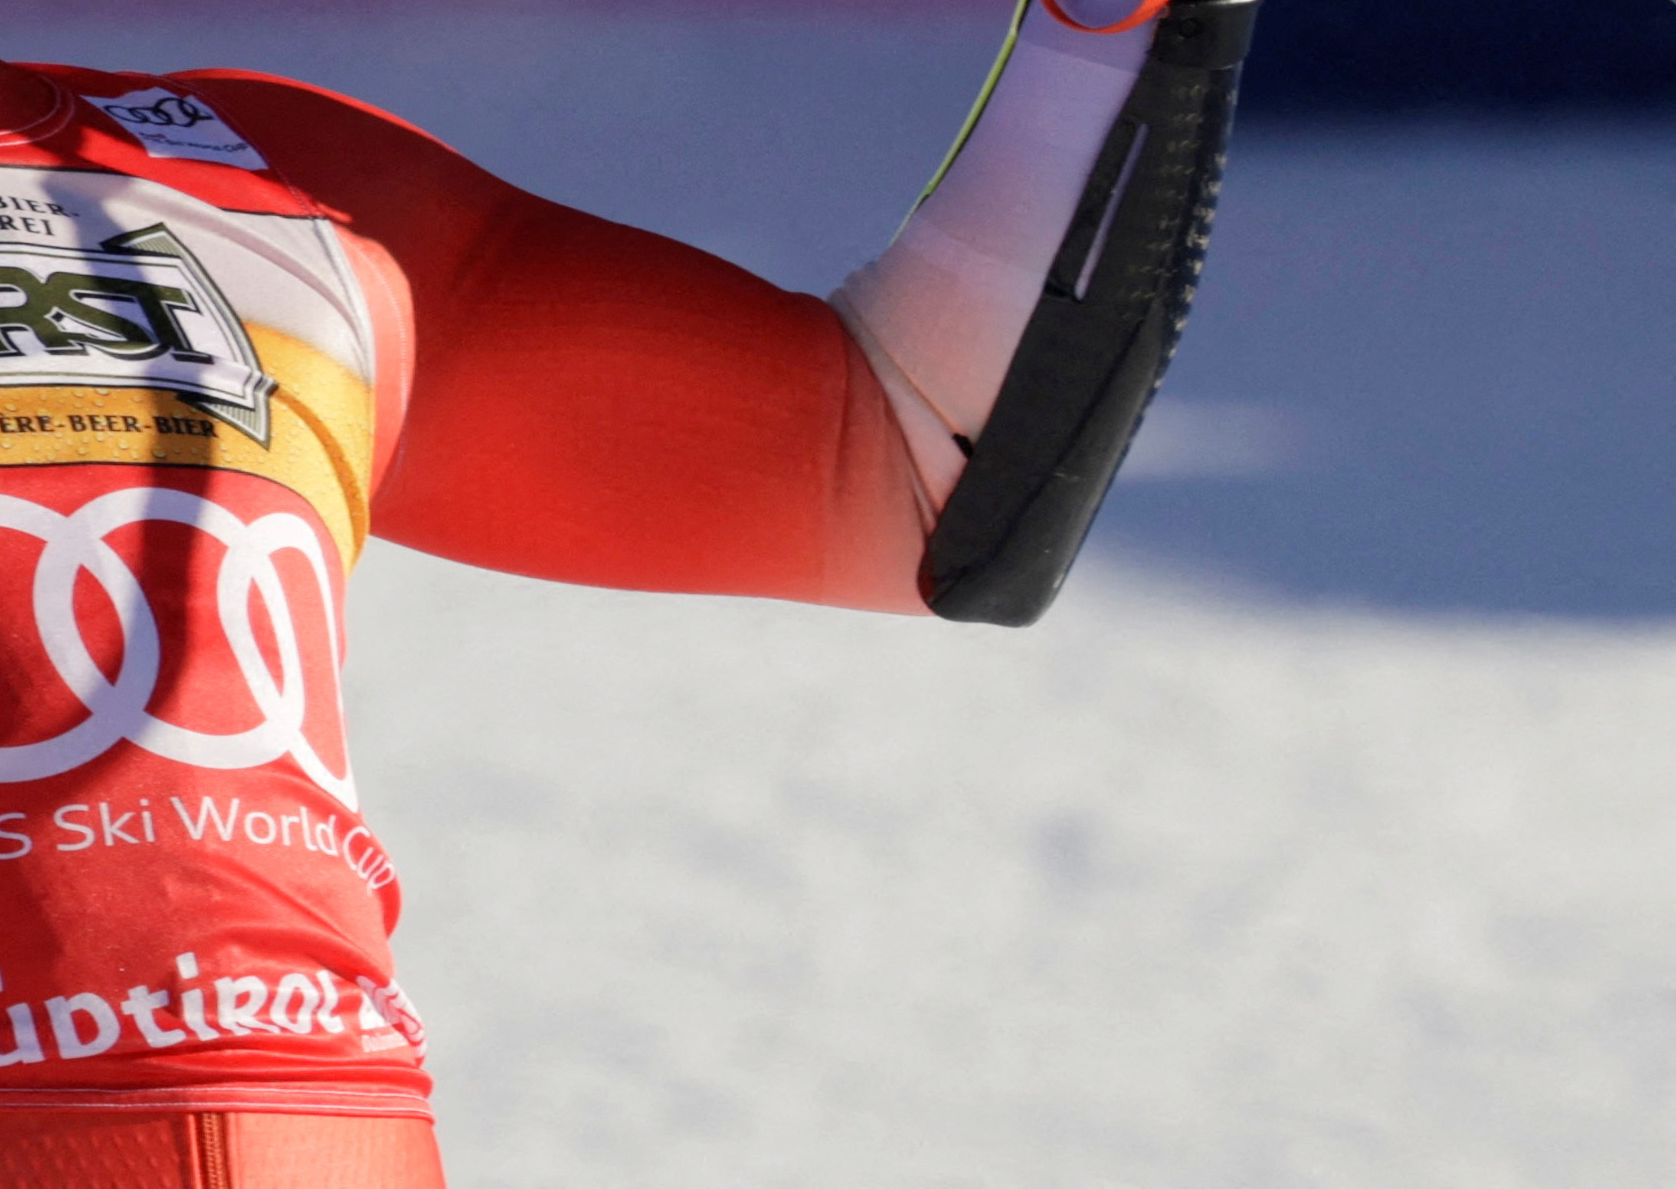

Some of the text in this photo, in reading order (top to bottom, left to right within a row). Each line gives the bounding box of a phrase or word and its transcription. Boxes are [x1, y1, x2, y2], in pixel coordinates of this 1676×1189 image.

[54, 799, 155, 851] Ski
[171, 796, 339, 857] World
[343, 826, 396, 897] Cup
